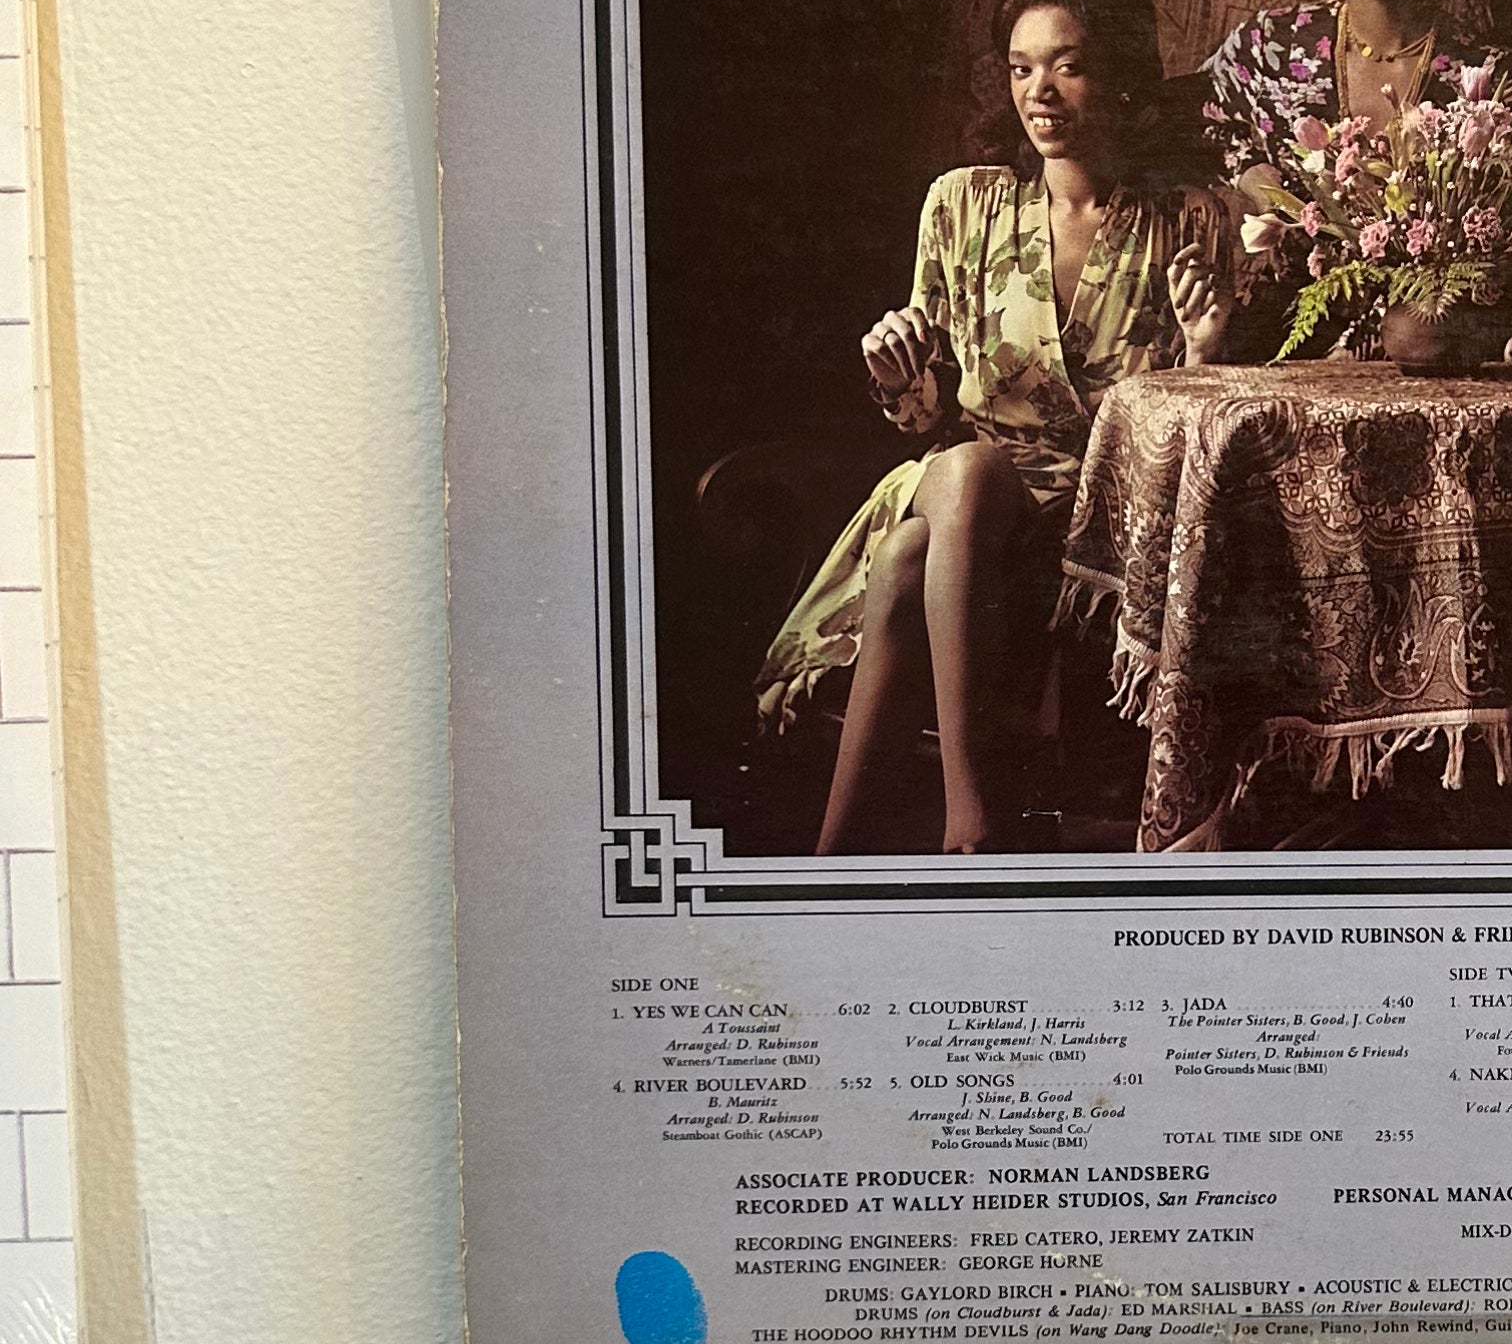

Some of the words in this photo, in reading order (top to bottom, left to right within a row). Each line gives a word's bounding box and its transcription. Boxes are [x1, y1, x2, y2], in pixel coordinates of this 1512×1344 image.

[1114, 930, 1224, 946] PRODUCED
[1233, 929, 1259, 944] BY
[1268, 929, 1333, 944] DAVID
[1341, 927, 1443, 944] RUBINSON
[1452, 927, 1466, 942] &
[1449, 968, 1487, 981] SIDE
[612, 979, 652, 992] SIDE
[660, 978, 698, 991] ONE
[888, 1004, 900, 1015] 2.
[909, 1000, 1028, 1014] CLOUDBURST
[1114, 1000, 1144, 1012] 3:12
[1162, 1000, 1173, 1012] 3.
[1182, 998, 1227, 1015] JADA
[1382, 996, 1413, 1008] 4:40
[1450, 997, 1461, 1008] 1.
[612, 1008, 624, 1019] 1.
[633, 1006, 665, 1018] YES
[671, 1005, 699, 1018] WE
[705, 1004, 743, 1018] CAN
[749, 1004, 787, 1017] CAN
[838, 1003, 870, 1015] 6:02
[890, 1077, 901, 1089] 5.
[911, 1075, 947, 1088] OLD
[957, 1074, 1014, 1087] SONGS
[1113, 1073, 1143, 1085] 4:01
[1449, 1069, 1461, 1081] 4.
[613, 1080, 625, 1093] 4.
[634, 1080, 688, 1092] RIVER
[696, 1078, 806, 1091] BOULEVARD
[841, 1078, 871, 1089] 5:52
[942, 1126, 970, 1136] West
[976, 1125, 1024, 1137] Berkeley
[1029, 1124, 1063, 1134] Sound
[1068, 1124, 1092, 1134] Co./
[1163, 1132, 1215, 1144] TOTAL
[1223, 1132, 1260, 1143] TIME
[1269, 1131, 1302, 1142] SIDE
[1310, 1130, 1342, 1142] ONE
[1376, 1130, 1413, 1143] 23:55
[931, 1139, 959, 1149] Polo
[961, 1137, 1012, 1149] Grounds
[1015, 1138, 1049, 1148] Music
[1053, 1137, 1087, 1150] (BMI)
[736, 1172, 848, 1189] ASSOCIATE
[856, 1170, 974, 1186] PRODUCER:
[989, 1168, 1078, 1184] NORMAN
[1088, 1165, 1209, 1182] LANDSBERG
[736, 1198, 848, 1214] RECORDED
[857, 1198, 884, 1212] AT
[893, 1196, 964, 1211] WALLY
[973, 1194, 1049, 1210] HEIDER
[1059, 1192, 1149, 1209] STUDIOS,
[1157, 1192, 1187, 1206] San
[1195, 1191, 1277, 1205] Francisco
[1334, 1188, 1439, 1203] PERSONAL
[735, 1236, 842, 1251] RECORDING
[850, 1234, 957, 1249] ENGINEERS:
[971, 1233, 1018, 1246] FRED
[1026, 1231, 1103, 1246] CATERO,
[1110, 1229, 1180, 1244] JEREMY
[1187, 1228, 1253, 1242] ZATKIN
[735, 1259, 841, 1275] MASTERING
[848, 1258, 946, 1272] ENGINEER:
[959, 1256, 1034, 1270] GEORGE
[1040, 1254, 1103, 1269] HORNE
